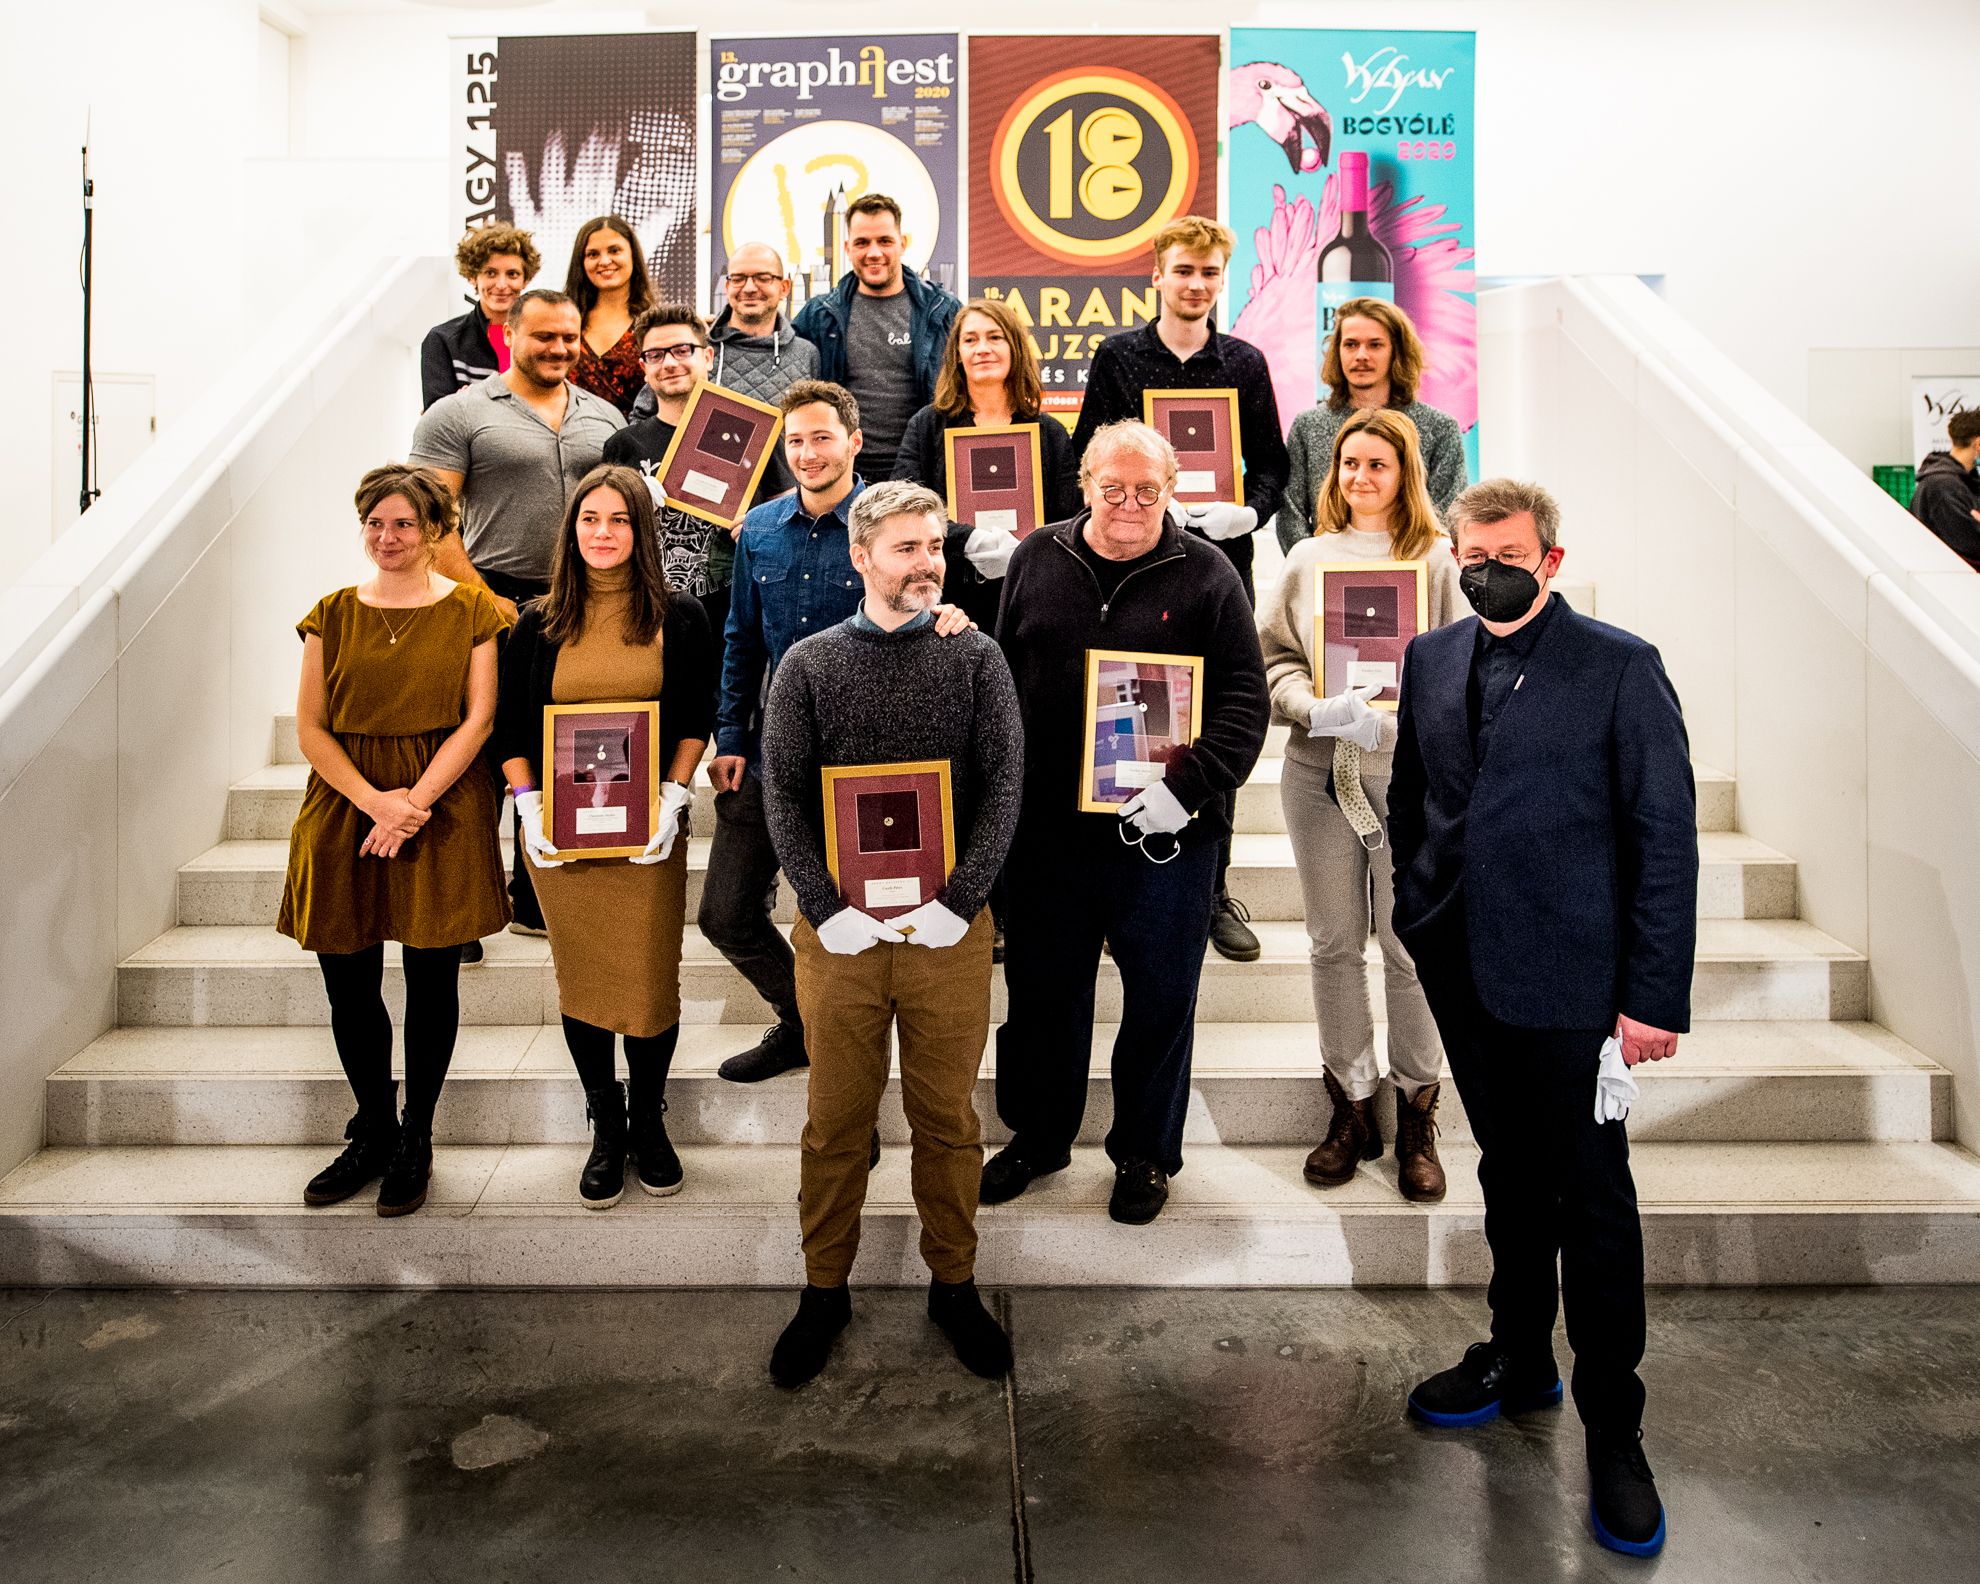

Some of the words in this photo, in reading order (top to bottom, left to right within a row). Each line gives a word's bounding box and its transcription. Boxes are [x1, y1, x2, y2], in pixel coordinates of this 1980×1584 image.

[467, 53, 498, 129] 125
[915, 86, 950, 98] 2020
[1343, 112, 1455, 136] BOGYÓLÉ
[1397, 141, 1456, 160] 2020
[1043, 106, 1143, 220] 18
[1004, 287, 1157, 327] ARAN
[1027, 334, 1106, 360] AJZS
[1040, 366, 1065, 384] ÉS
[1077, 369, 1089, 383] K
[1041, 396, 1078, 406] KTÓBER
